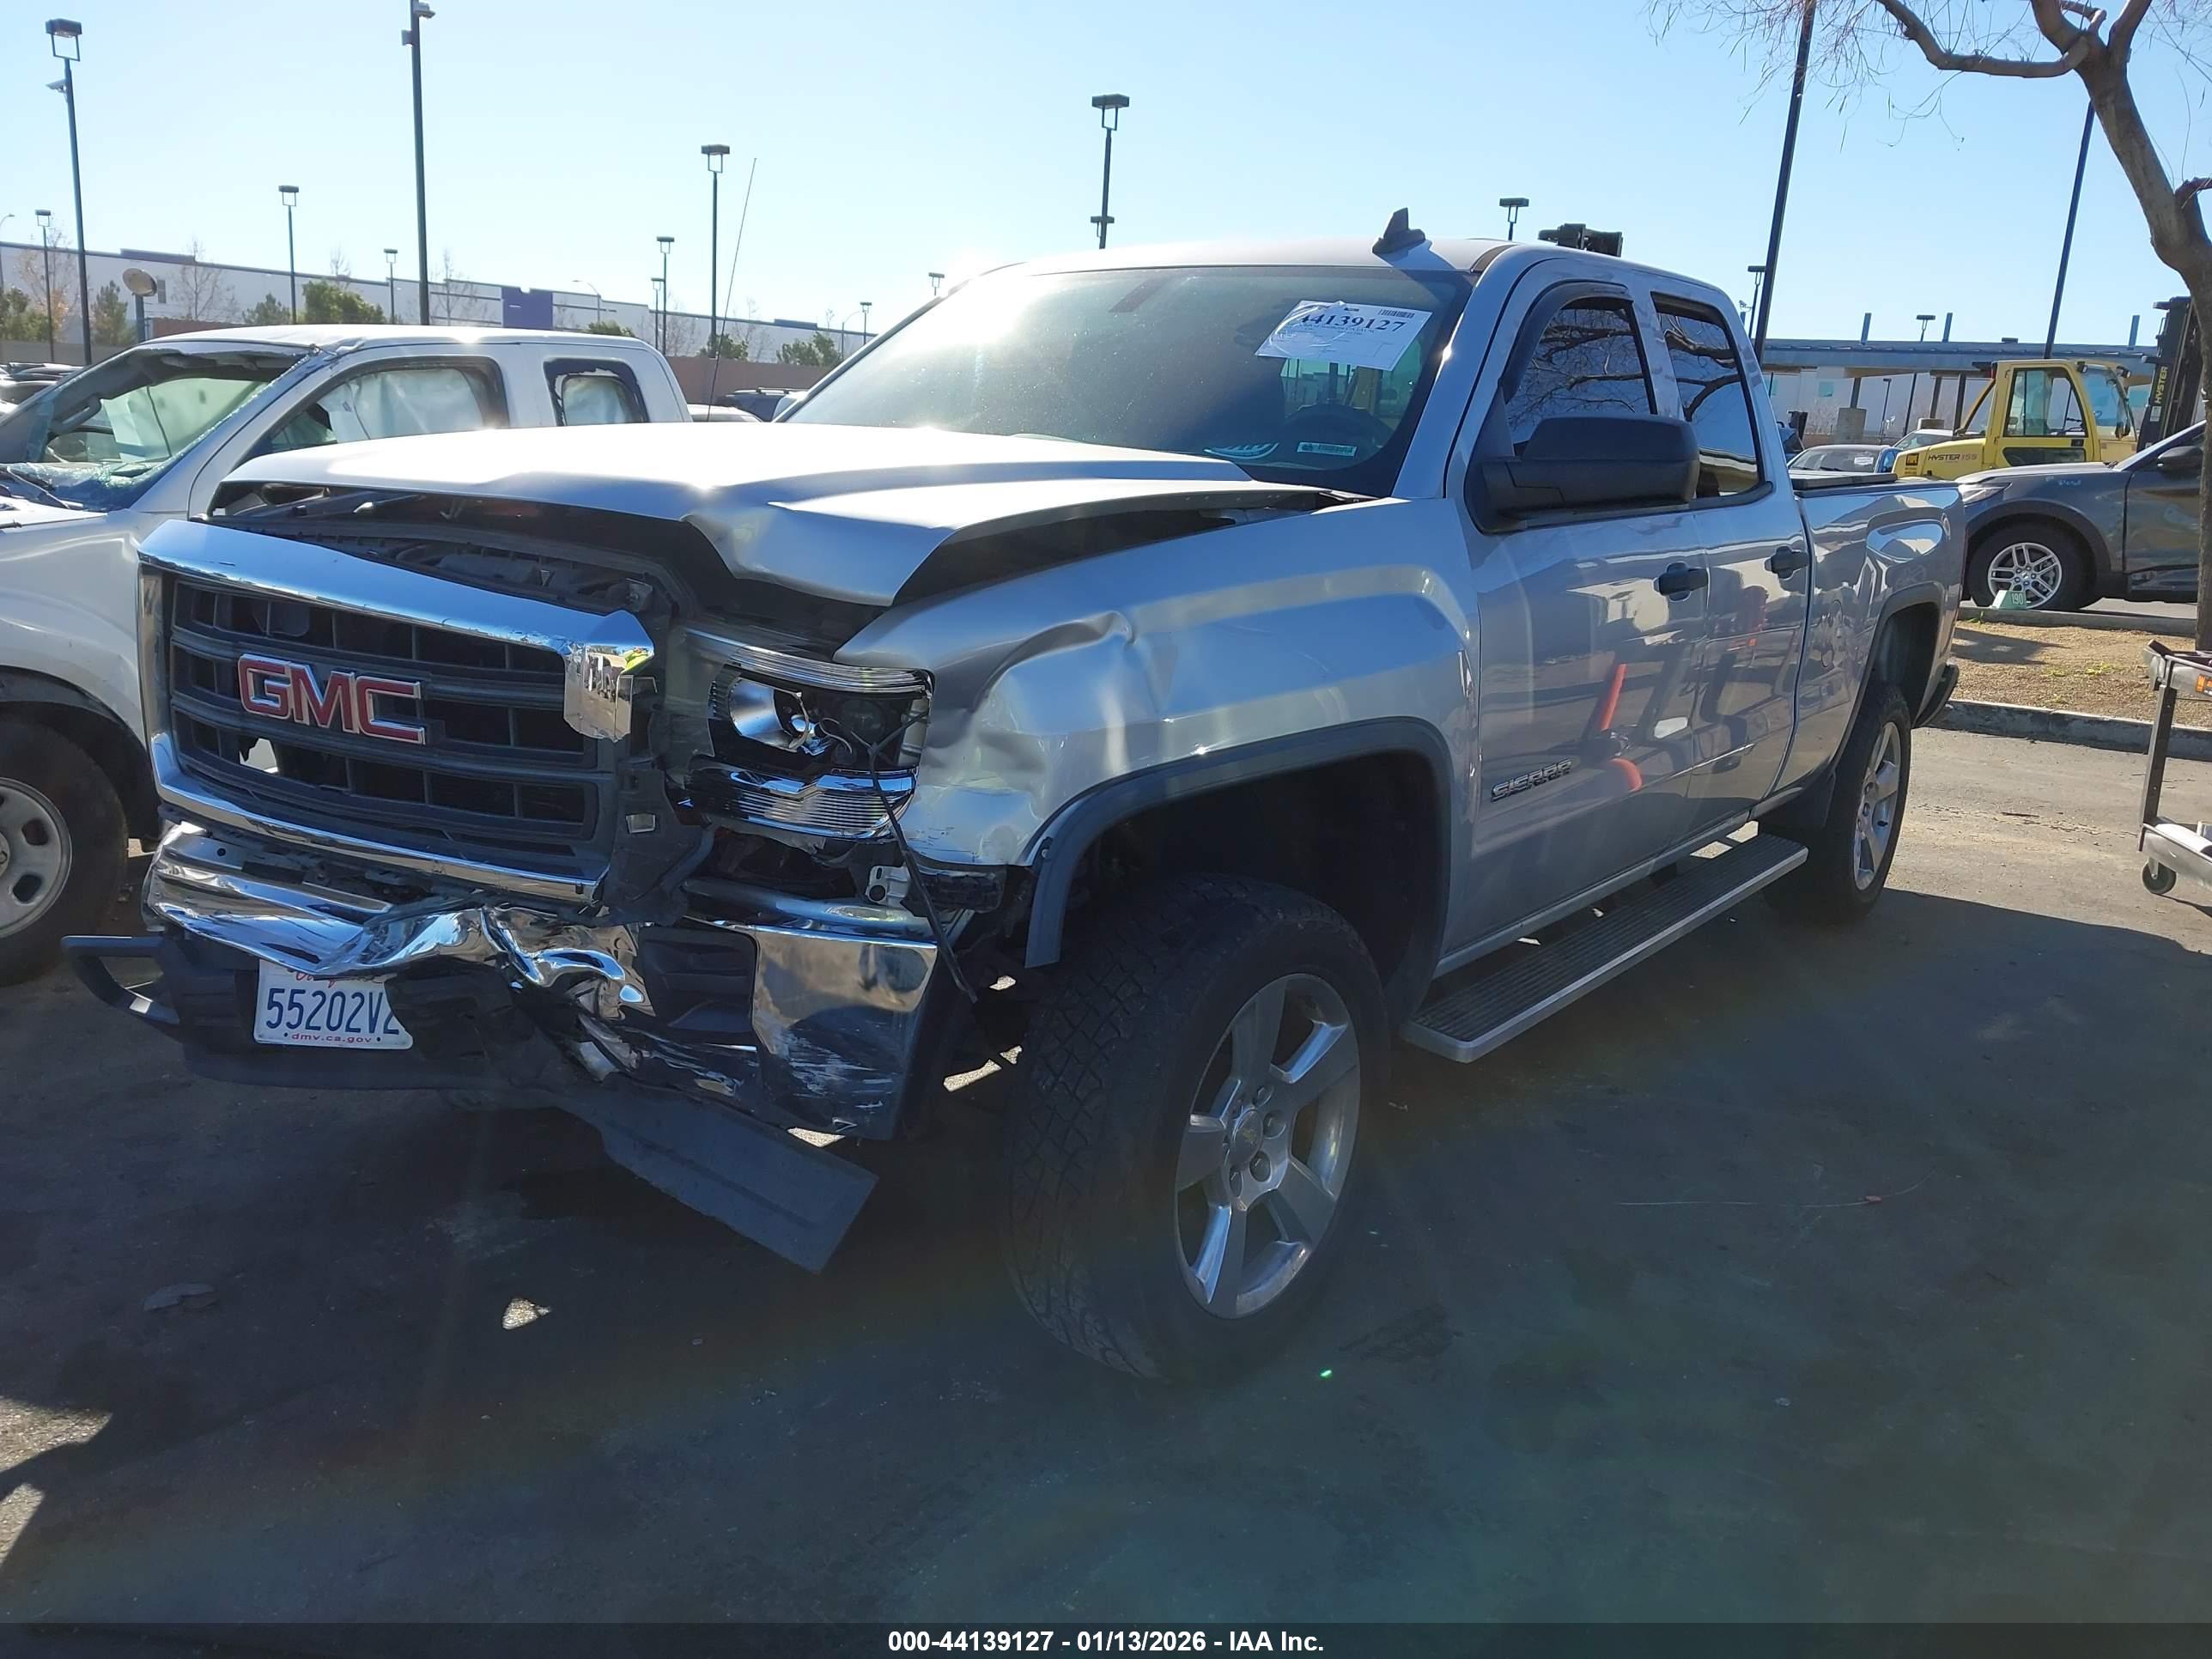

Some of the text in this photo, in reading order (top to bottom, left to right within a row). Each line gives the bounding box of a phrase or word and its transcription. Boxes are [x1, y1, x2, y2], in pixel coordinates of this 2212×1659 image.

[2154, 366, 2168, 404] HYSTER
[2011, 592, 2024, 605] 190
[238, 653, 426, 744] GMC
[291, 1033, 372, 1043] dmv.ca.gov
